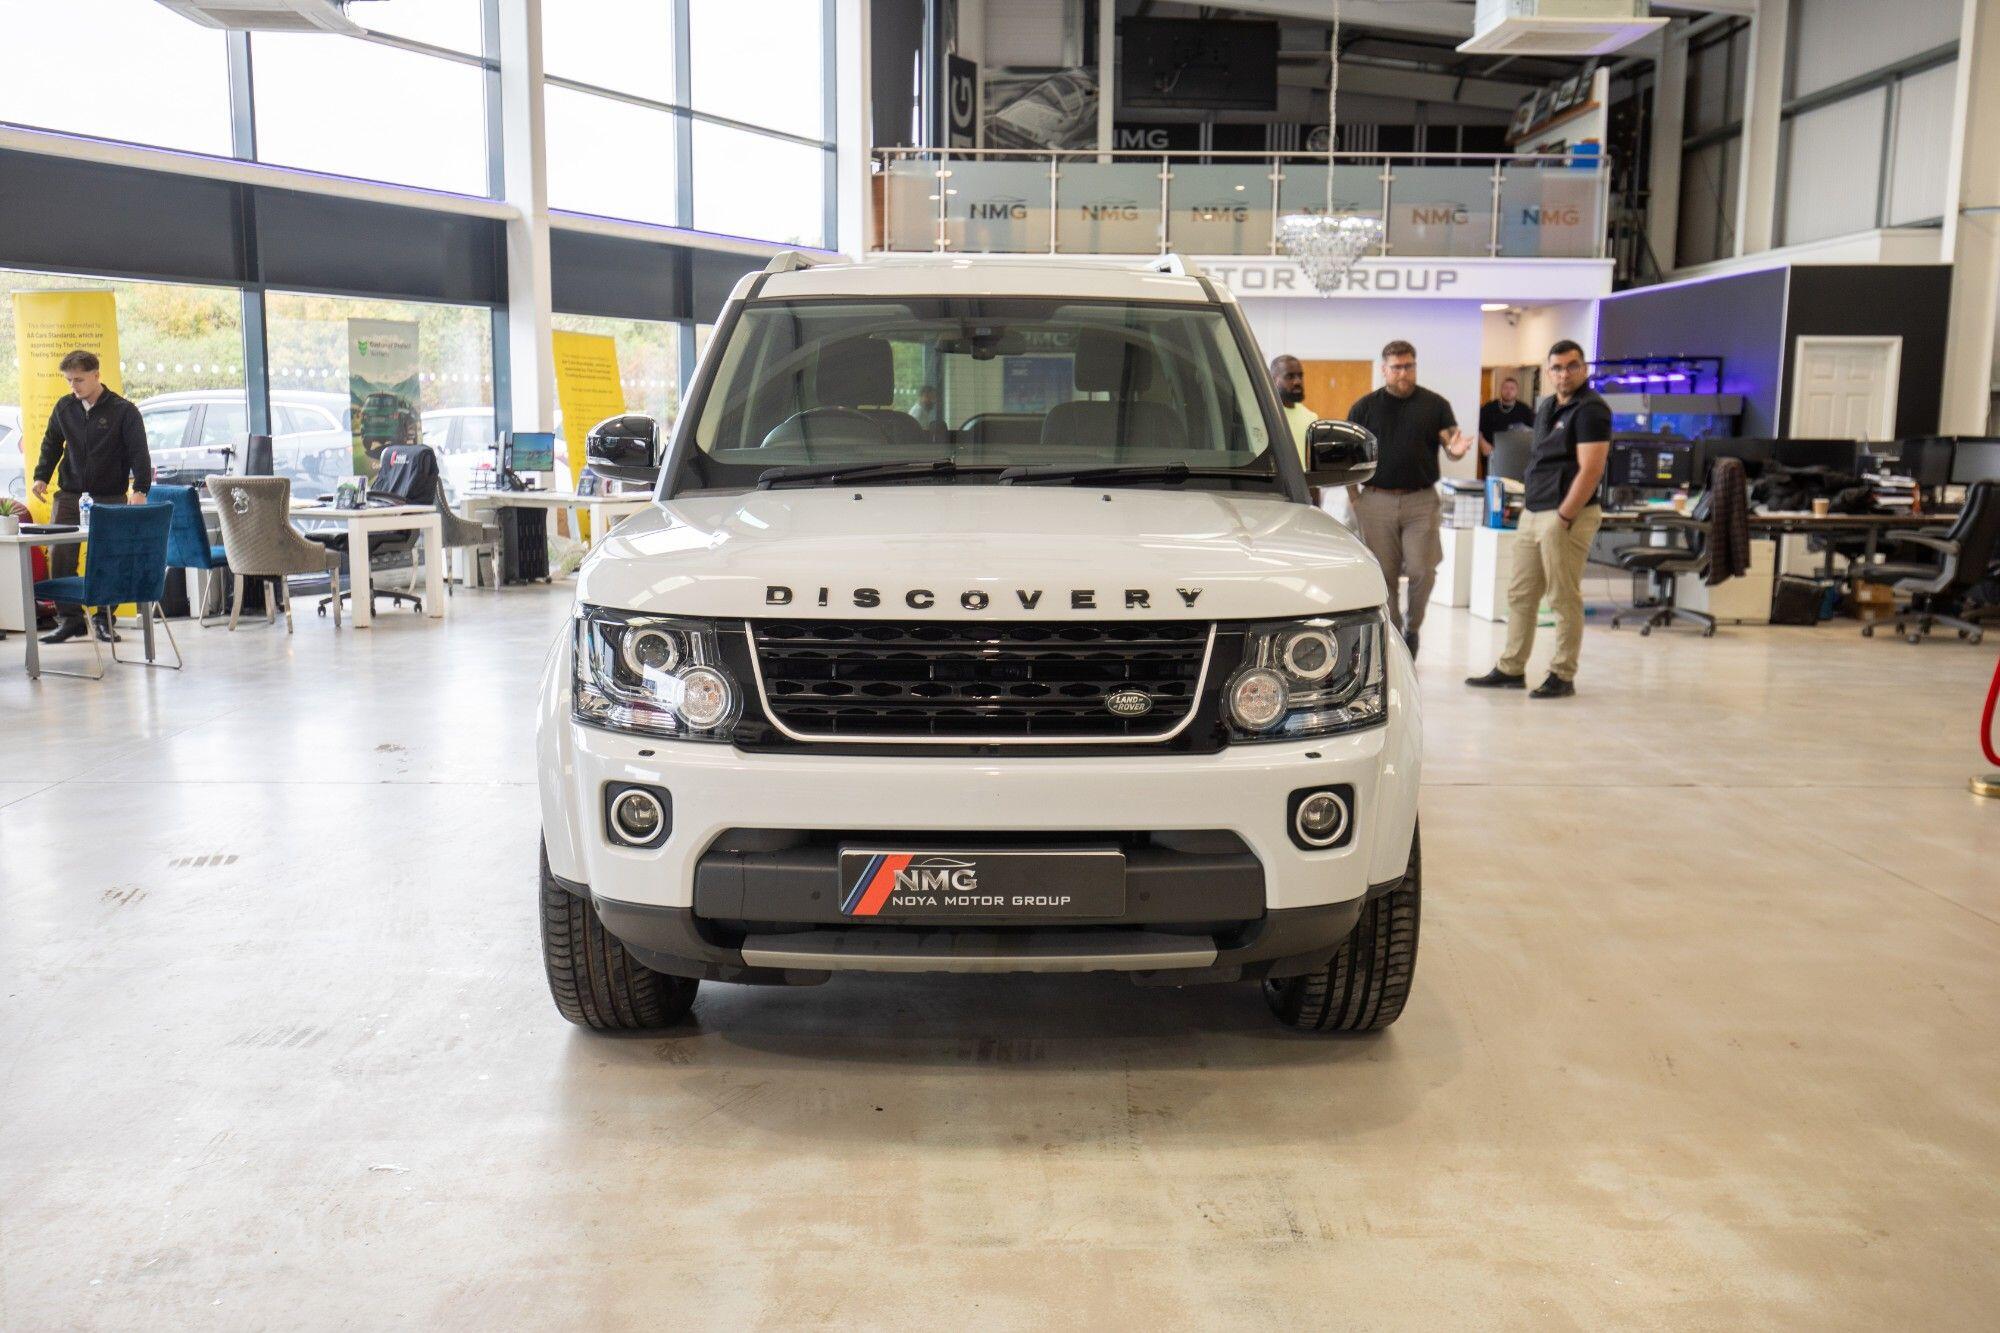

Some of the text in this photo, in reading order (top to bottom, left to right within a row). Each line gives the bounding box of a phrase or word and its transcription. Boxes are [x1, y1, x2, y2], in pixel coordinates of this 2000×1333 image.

[969, 203, 1028, 220] NMG
[1081, 204, 1139, 221] NMG
[1192, 206, 1248, 223] NMG
[1411, 208, 1469, 225] NMG
[1521, 208, 1580, 226] NMG
[1337, 270, 1458, 291] ROUP
[765, 585, 1203, 610] DISCOVERY
[1118, 703, 1146, 711] ROVER
[892, 869, 978, 892] NMG
[892, 896, 1071, 906] NOYA MOTOR GROUP
